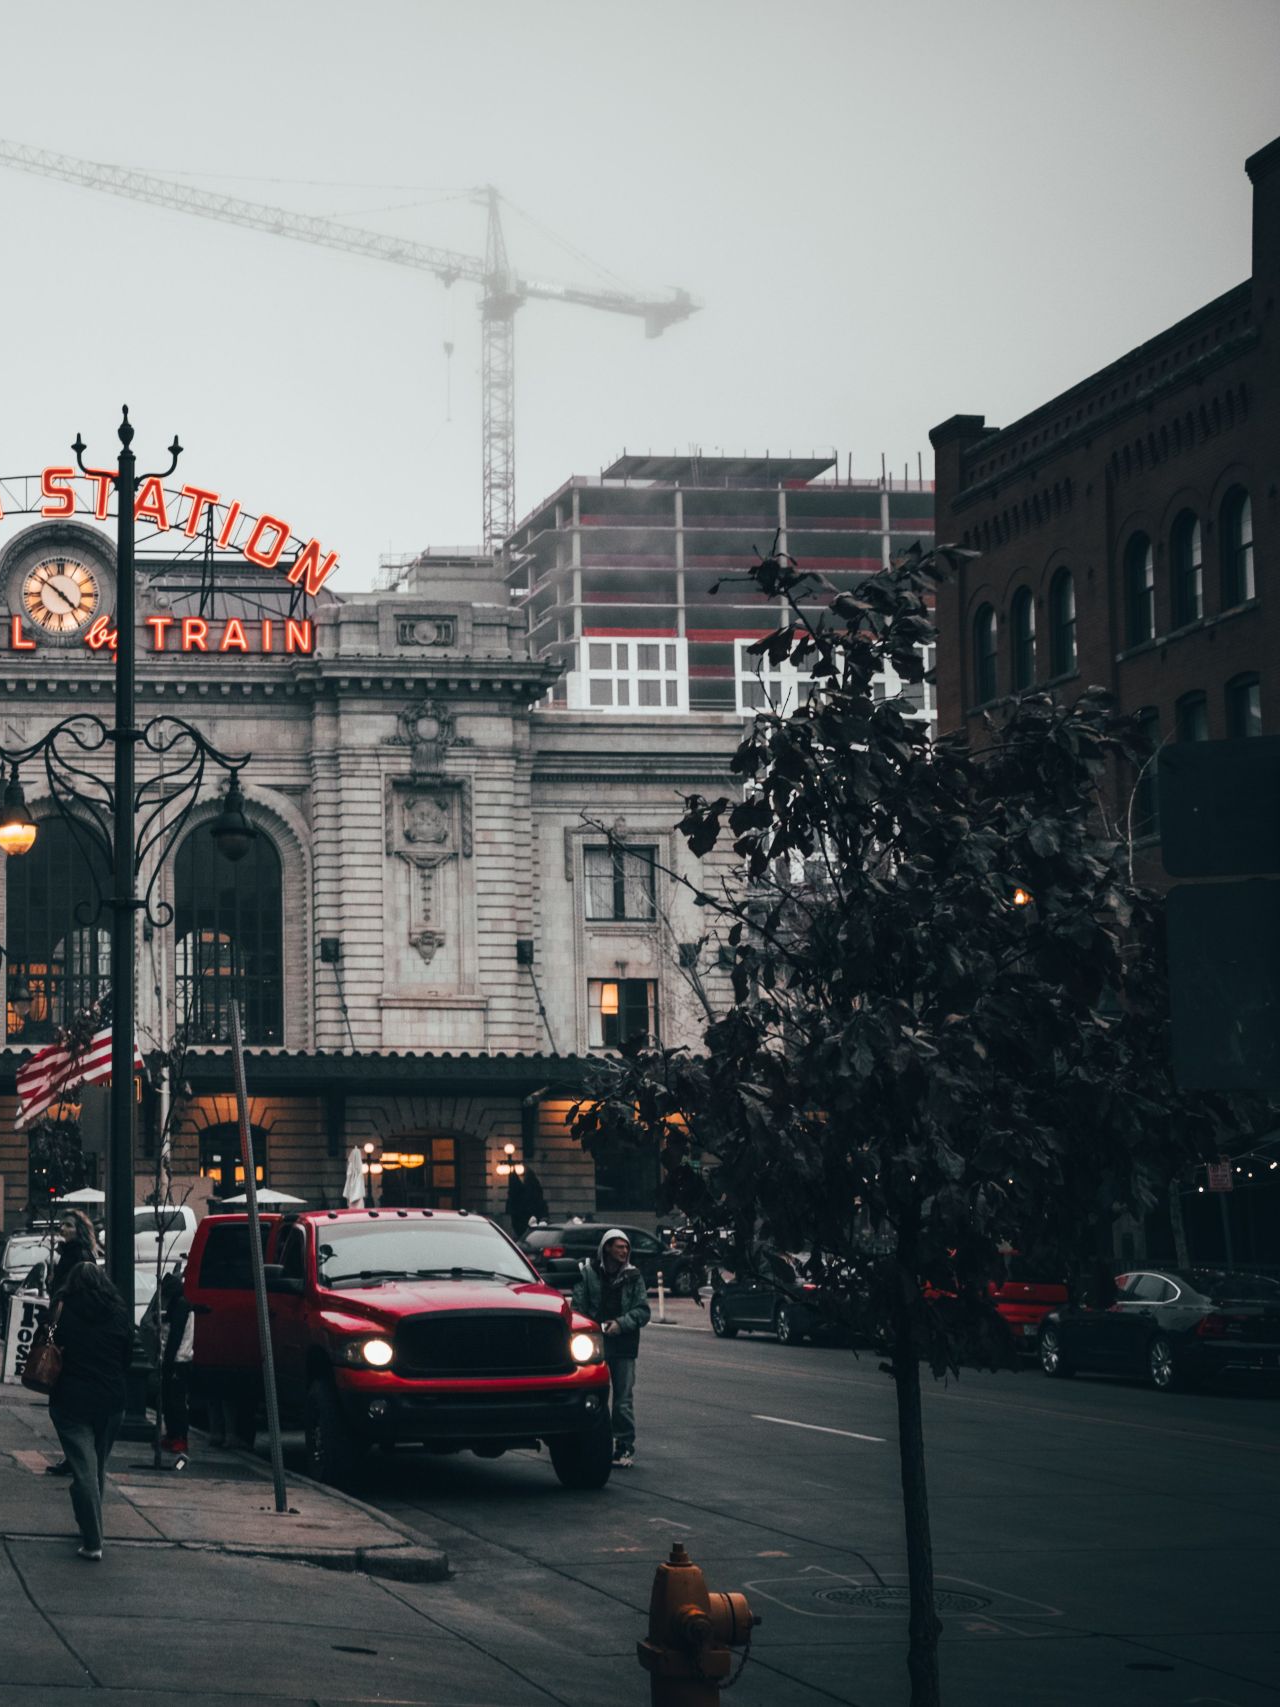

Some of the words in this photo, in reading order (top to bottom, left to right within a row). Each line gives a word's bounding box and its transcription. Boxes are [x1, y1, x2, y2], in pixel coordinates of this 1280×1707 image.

[40, 466, 339, 596] STATION
[84, 614, 118, 663] b
[145, 615, 316, 655] TRAIN
[67, 721, 216, 746] STTION
